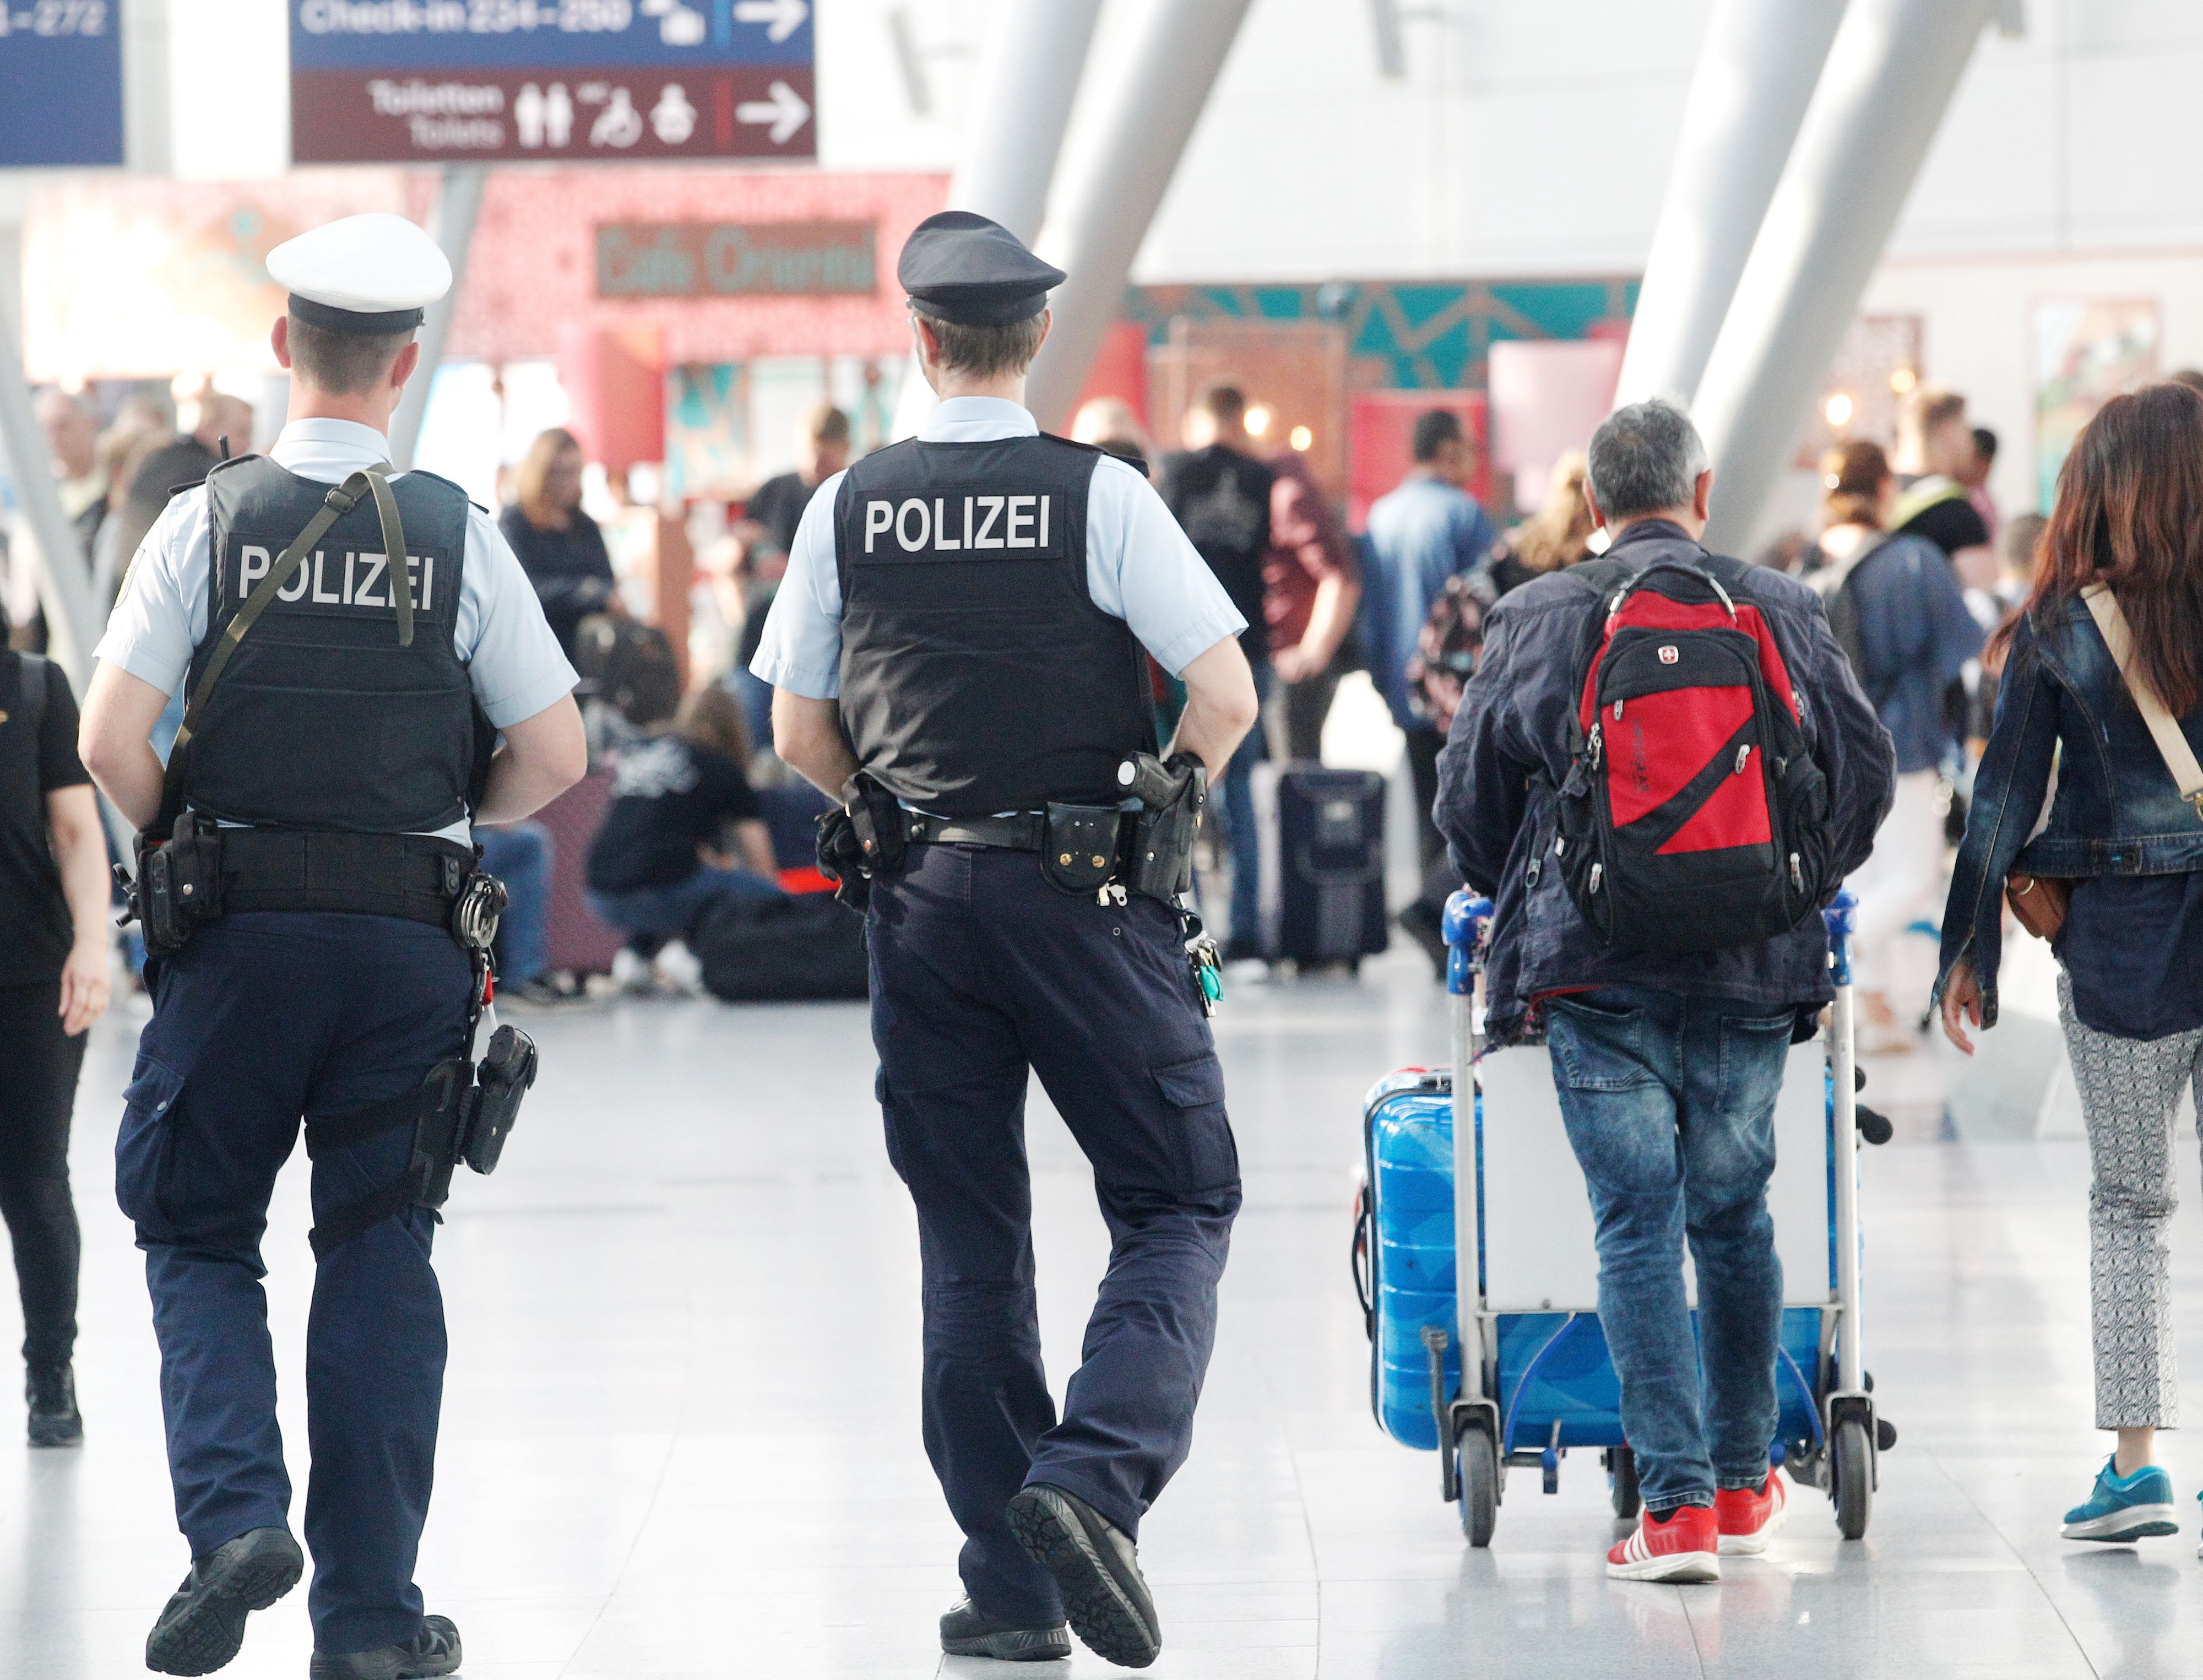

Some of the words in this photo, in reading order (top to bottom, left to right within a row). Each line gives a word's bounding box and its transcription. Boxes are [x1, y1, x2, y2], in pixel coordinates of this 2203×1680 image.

[371, 81, 503, 113] Toiletten
[411, 117, 502, 148] Toilets
[864, 495, 1050, 553] POLIZEI
